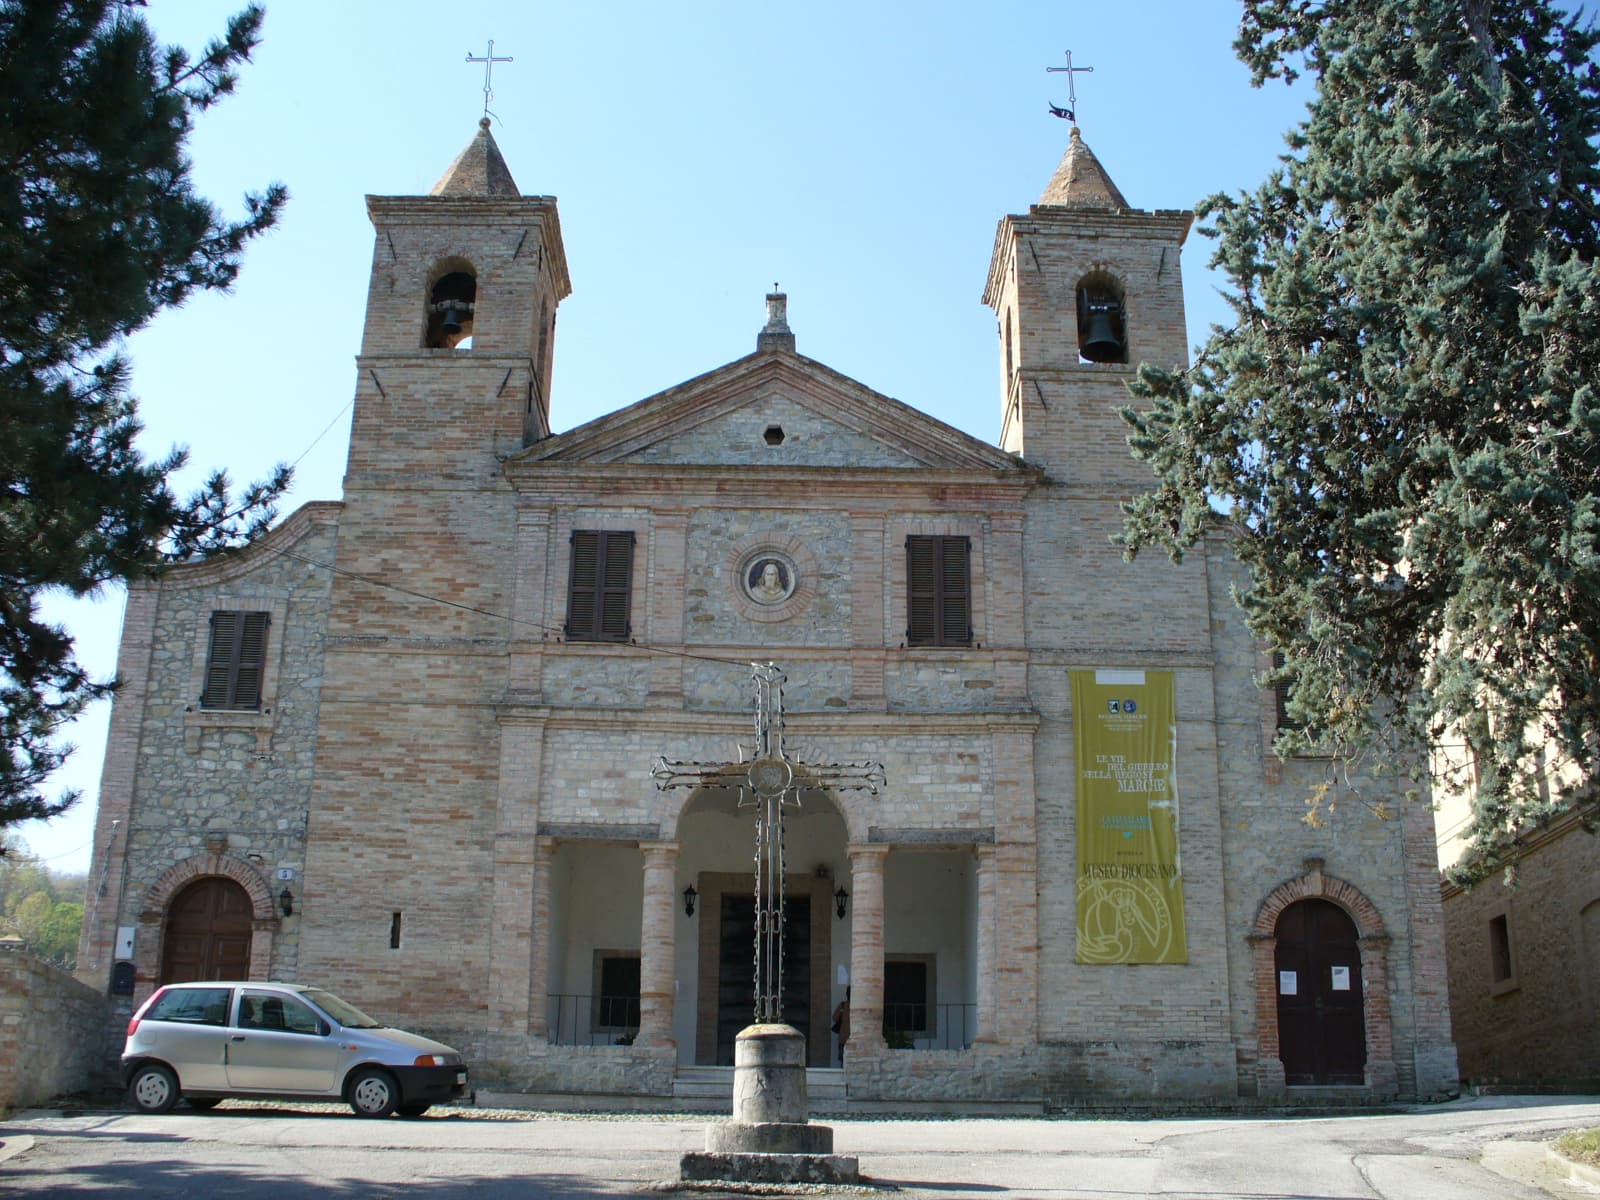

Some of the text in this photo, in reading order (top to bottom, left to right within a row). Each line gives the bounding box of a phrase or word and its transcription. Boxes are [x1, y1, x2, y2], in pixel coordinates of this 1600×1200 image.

[1096, 754, 1126, 763] LE VIE
[1108, 763, 1127, 771] DEL
[1118, 779, 1167, 792] MARCHE
[1083, 863, 1177, 879] MUSEO DIOCESANO
